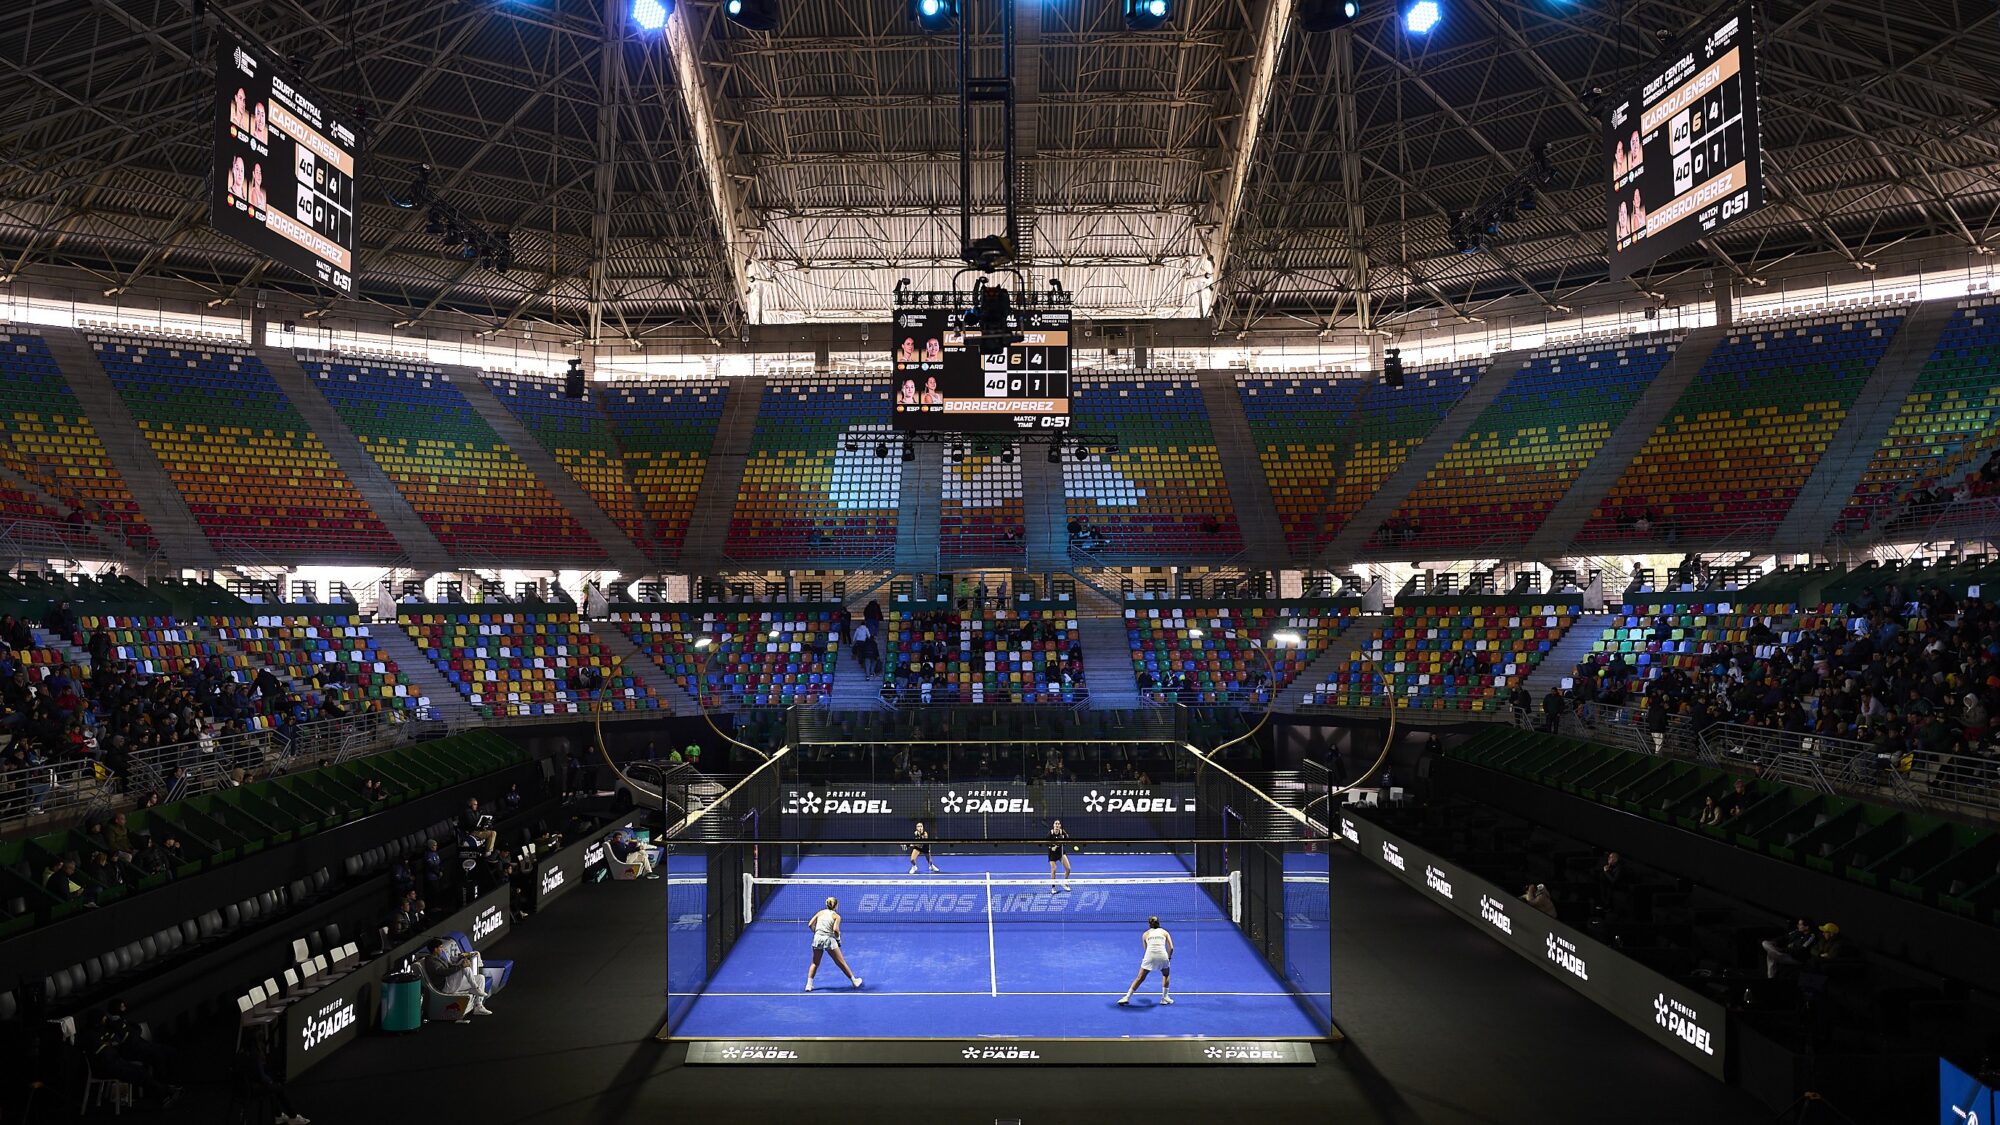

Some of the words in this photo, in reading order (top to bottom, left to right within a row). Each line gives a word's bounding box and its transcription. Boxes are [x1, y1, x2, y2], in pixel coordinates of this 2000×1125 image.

[1643, 74, 1664, 98] COURT
[1665, 53, 1694, 82] CENTRAL
[272, 76, 294, 99] COURT
[295, 93, 322, 121] CENTRAL
[1642, 64, 1720, 132] ICARDO/JENSEN
[1674, 121, 1688, 142] 40
[1692, 112, 1701, 132] 6
[1709, 101, 1719, 120] 4
[238, 132, 249, 143] ESP
[269, 105, 340, 164] ICARDO/JENSEN
[1676, 162, 1690, 181] 40
[1694, 154, 1703, 173] 0
[1713, 144, 1719, 162] 1
[300, 159, 312, 177] 40
[316, 168, 324, 184] 6
[330, 177, 337, 194] 4
[1646, 173, 1732, 232] BORRERO/PEREZ
[1722, 190, 1748, 220] 0:51
[298, 196, 312, 214] 40
[315, 206, 323, 222] 0
[330, 214, 335, 230] 1
[1699, 206, 1718, 222] MATCH
[1702, 218, 1716, 230] TIME
[267, 210, 342, 263] BORRERO/PEREZ
[316, 260, 332, 273] MATCH
[318, 270, 330, 281] TIME
[333, 270, 352, 292] 0:51
[986, 355, 1005, 364] 40
[1010, 354, 1021, 364] 6
[1031, 354, 1042, 364] 4
[986, 380, 1005, 389] 40
[1011, 380, 1021, 390] 0
[1034, 380, 1040, 390] 1
[945, 401, 1054, 411] BORRERO/PEREZ
[1041, 416, 1070, 427] 0:51
[824, 800, 892, 814] PADEL
[965, 799, 1034, 813] PADEL
[1107, 799, 1177, 812] PADEL
[1345, 826, 1359, 844] PADEL
[589, 847, 604, 866] PADEL
[1388, 851, 1405, 871] PADEL
[548, 871, 564, 891] PADEL
[1433, 877, 1453, 899] PADEL
[858, 894, 978, 912] BUENOS
[981, 893, 1071, 912] AIRES
[1489, 898, 1504, 911] PREMIER
[481, 910, 503, 938] PADEL
[1489, 907, 1512, 935] PADEL
[1557, 937, 1576, 952] PREMIER
[1556, 947, 1588, 980] PADEL
[319, 998, 342, 1018] PREMIER
[1670, 999, 1696, 1020] PREMIER
[317, 1004, 356, 1043] PADEL
[1669, 1012, 1714, 1055] PADEL
[741, 1051, 798, 1059] PADEL
[982, 1051, 1040, 1059] PADEL
[1226, 1051, 1283, 1059] PADEL
